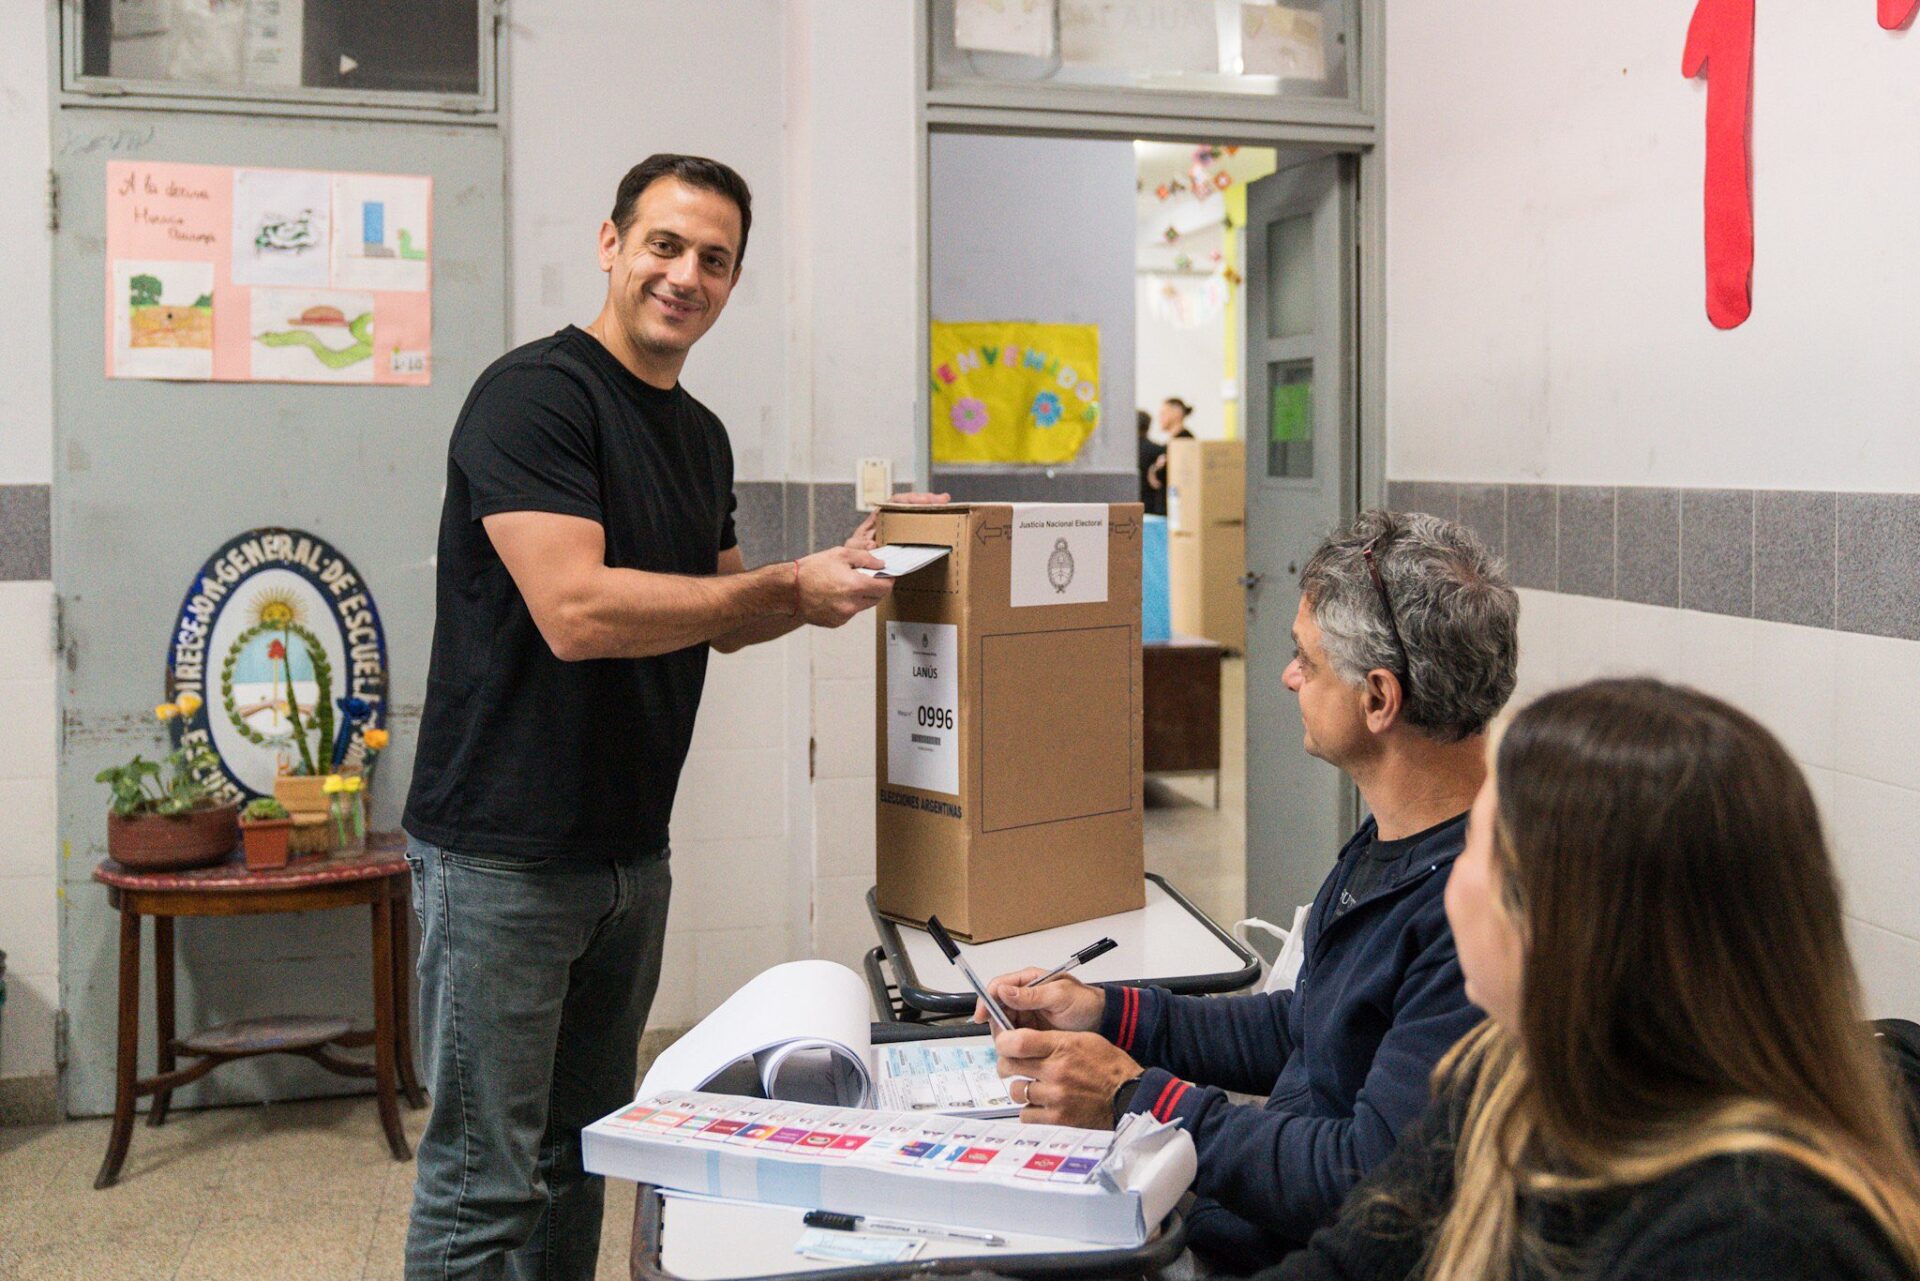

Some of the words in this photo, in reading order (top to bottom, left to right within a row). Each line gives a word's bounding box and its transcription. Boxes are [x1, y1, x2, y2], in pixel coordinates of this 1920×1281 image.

[1019, 520, 1045, 529] Justicia
[1046, 520, 1074, 528] Nacional
[1075, 519, 1103, 527] Electoral
[214, 534, 322, 583] GENERAL
[320, 559, 356, 597] DE
[912, 664, 938, 679] LANÚS
[917, 705, 953, 730] 0996
[880, 788, 919, 810] ELECCIONES
[920, 798, 962, 820] ARGENTINAS
